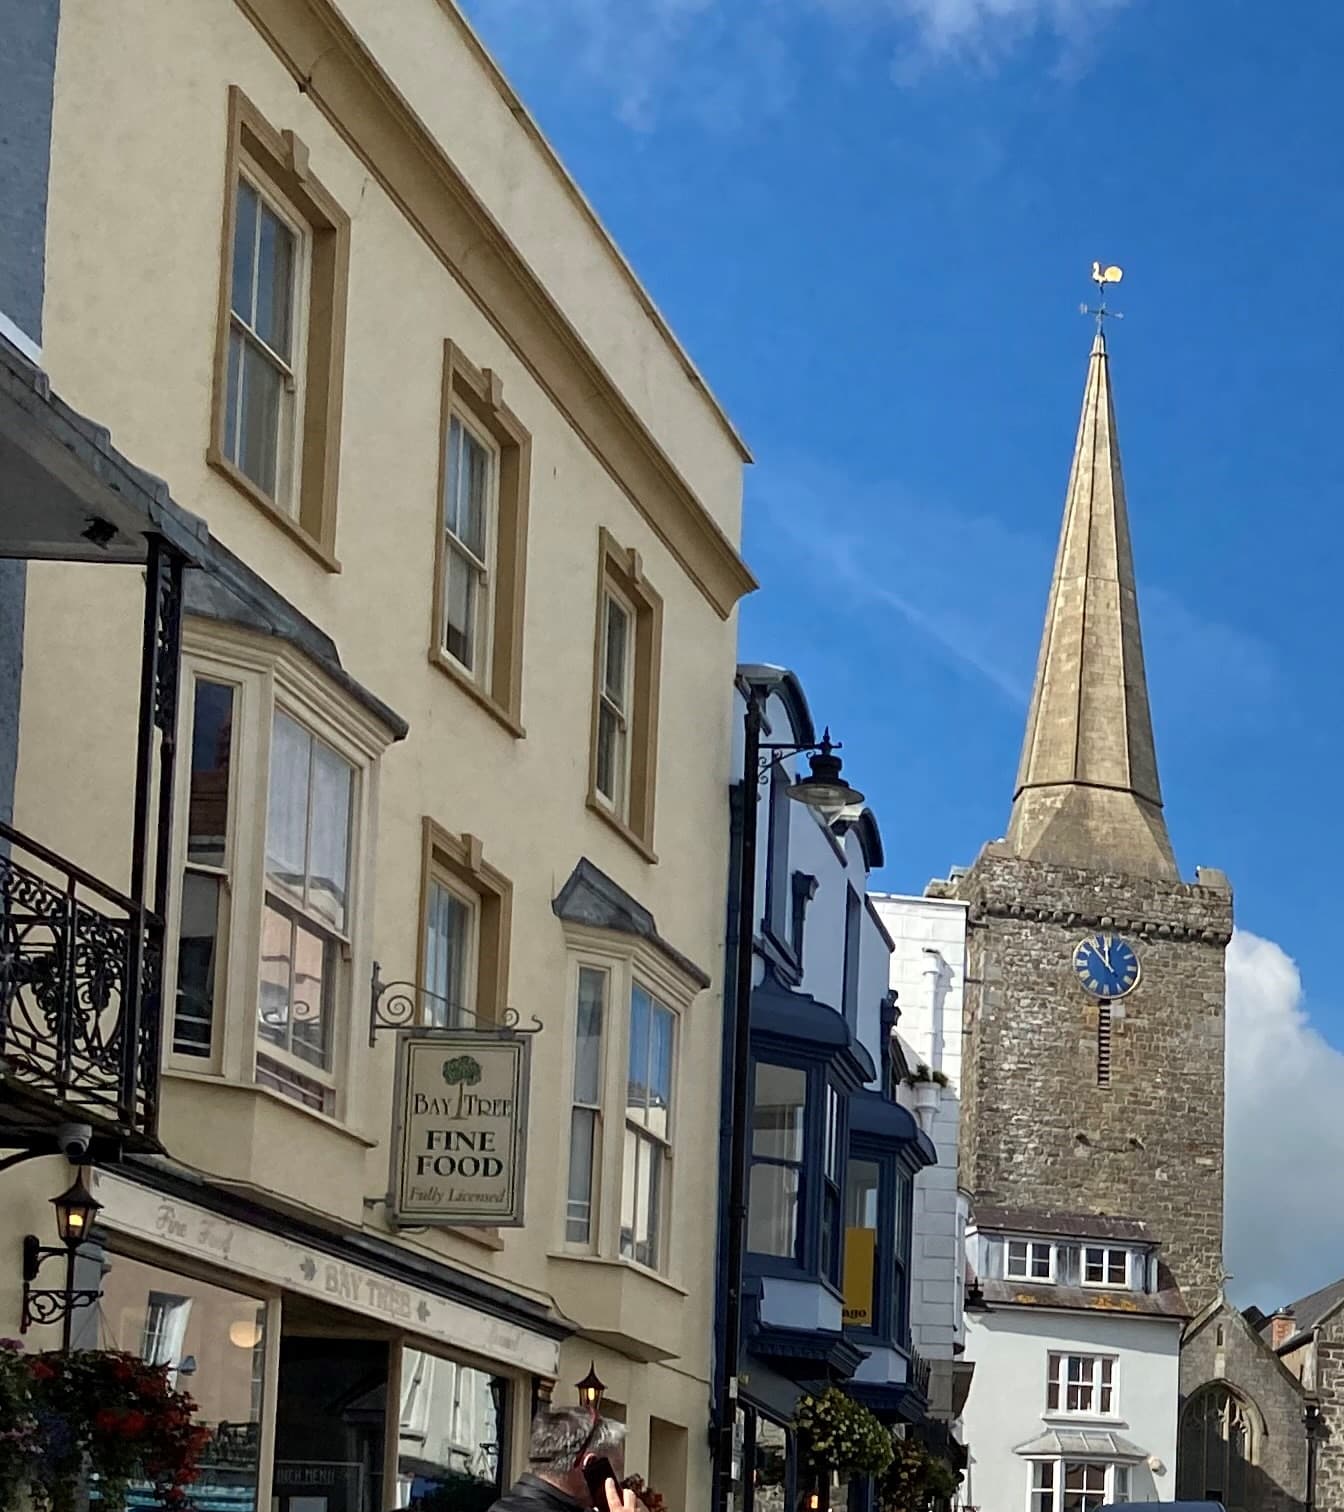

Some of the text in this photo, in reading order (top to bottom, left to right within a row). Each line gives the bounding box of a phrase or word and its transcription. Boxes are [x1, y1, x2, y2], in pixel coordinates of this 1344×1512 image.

[414, 1093, 512, 1118] BAY TREE
[426, 1130, 496, 1152] FINE
[416, 1155, 504, 1178] FOOD
[409, 1186, 506, 1205] Fully Licensed
[324, 1263, 412, 1318] BAY TREE
